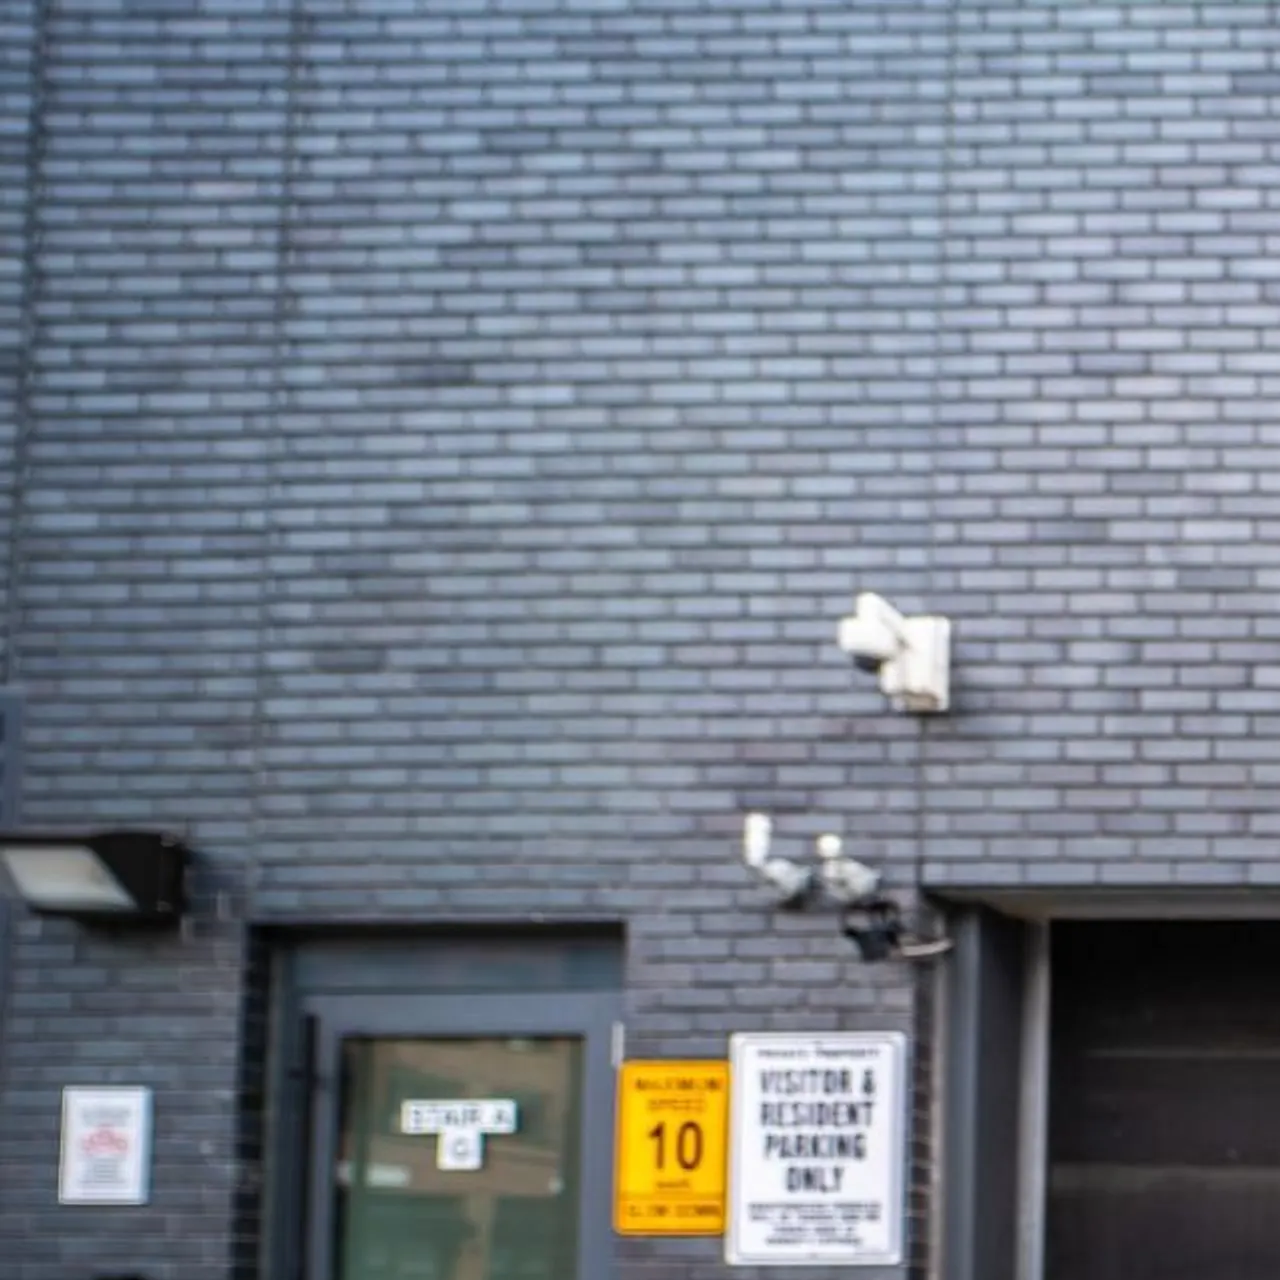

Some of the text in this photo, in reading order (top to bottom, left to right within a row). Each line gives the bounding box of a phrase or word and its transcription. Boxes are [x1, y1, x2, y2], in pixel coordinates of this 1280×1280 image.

[760, 1069, 876, 1096] VISITOR &
[760, 1101, 874, 1127] RESIDENT
[648, 1120, 705, 1171] 10
[765, 1133, 867, 1160] PARKING
[786, 1166, 844, 1193] ONLY
